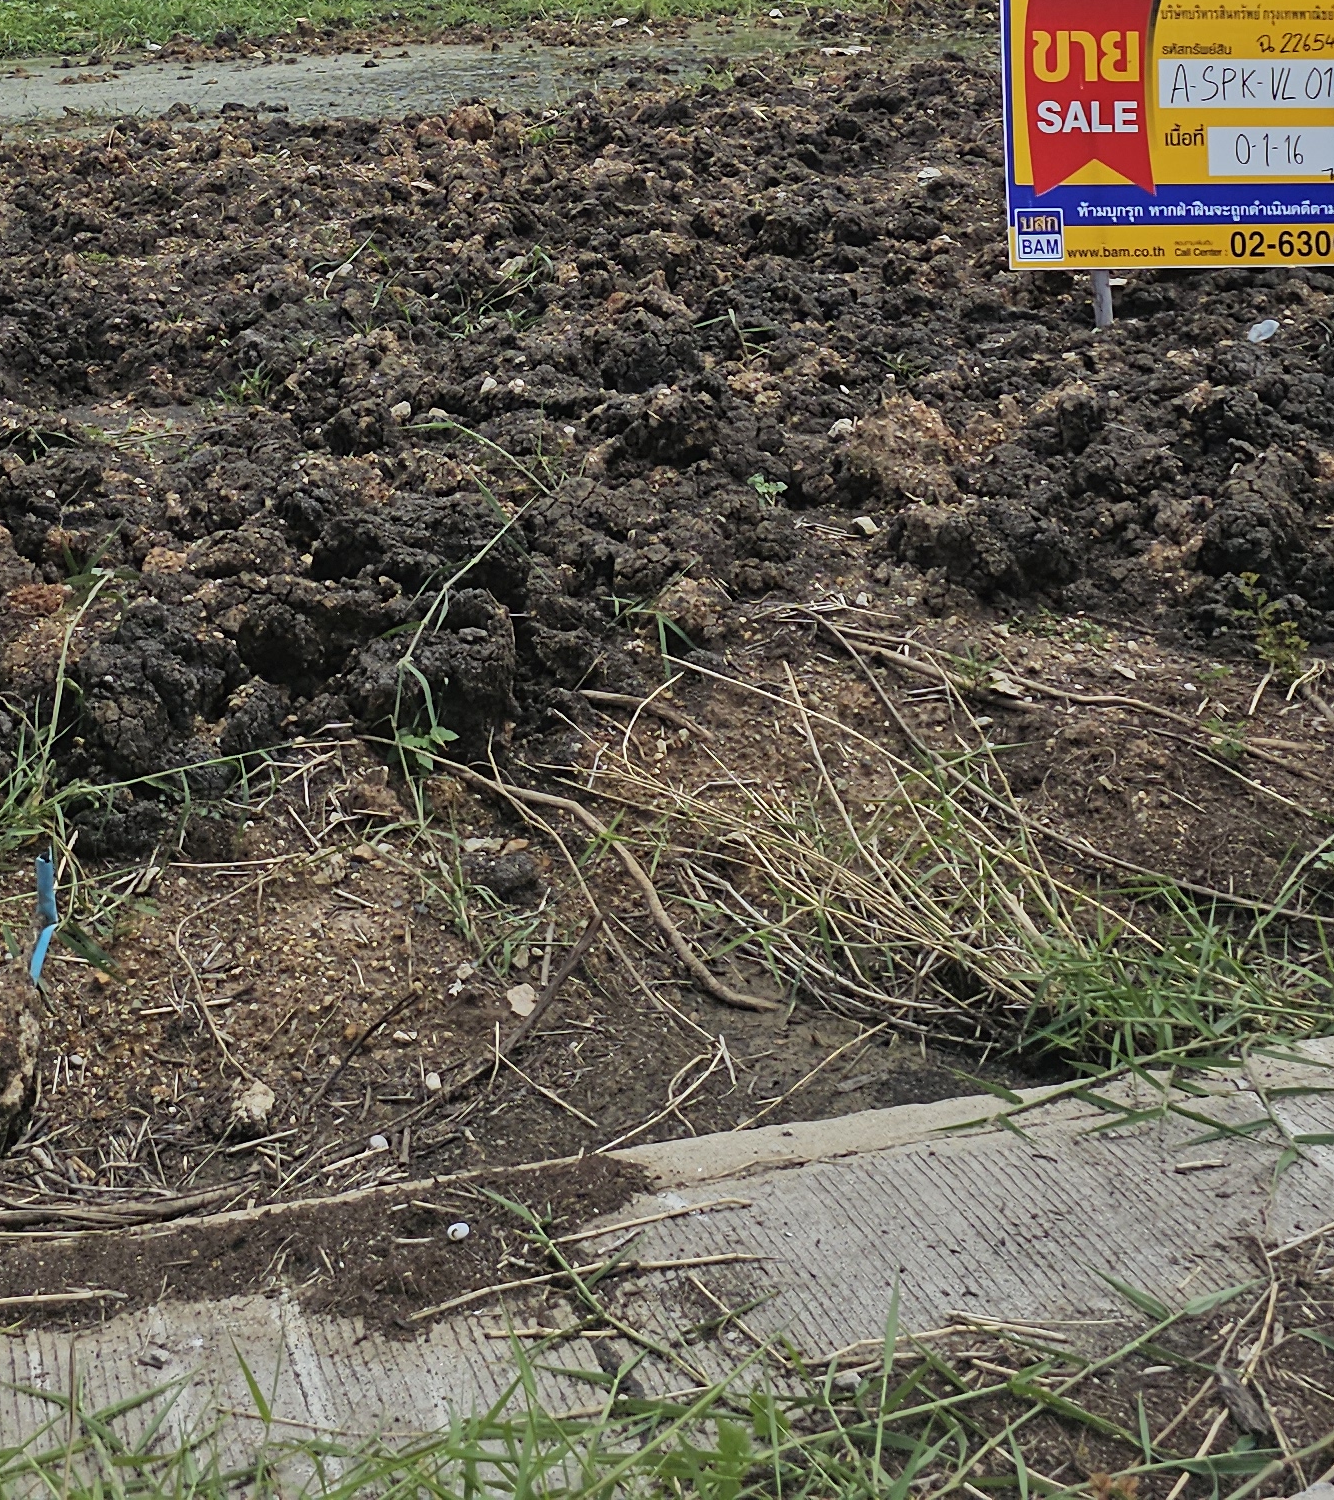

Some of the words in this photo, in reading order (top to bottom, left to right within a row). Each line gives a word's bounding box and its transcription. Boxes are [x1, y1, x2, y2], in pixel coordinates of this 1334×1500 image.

[1032, 30, 1140, 83] ขาย
[1037, 100, 1139, 133] SALE
[1164, 123, 1205, 147] เนื้อที่
[1076, 201, 1144, 223] ห้ามบุกรุก
[1020, 215, 1059, 233] บสก
[1022, 239, 1060, 255] BAM
[1067, 247, 1166, 259] www.bam.co.th
